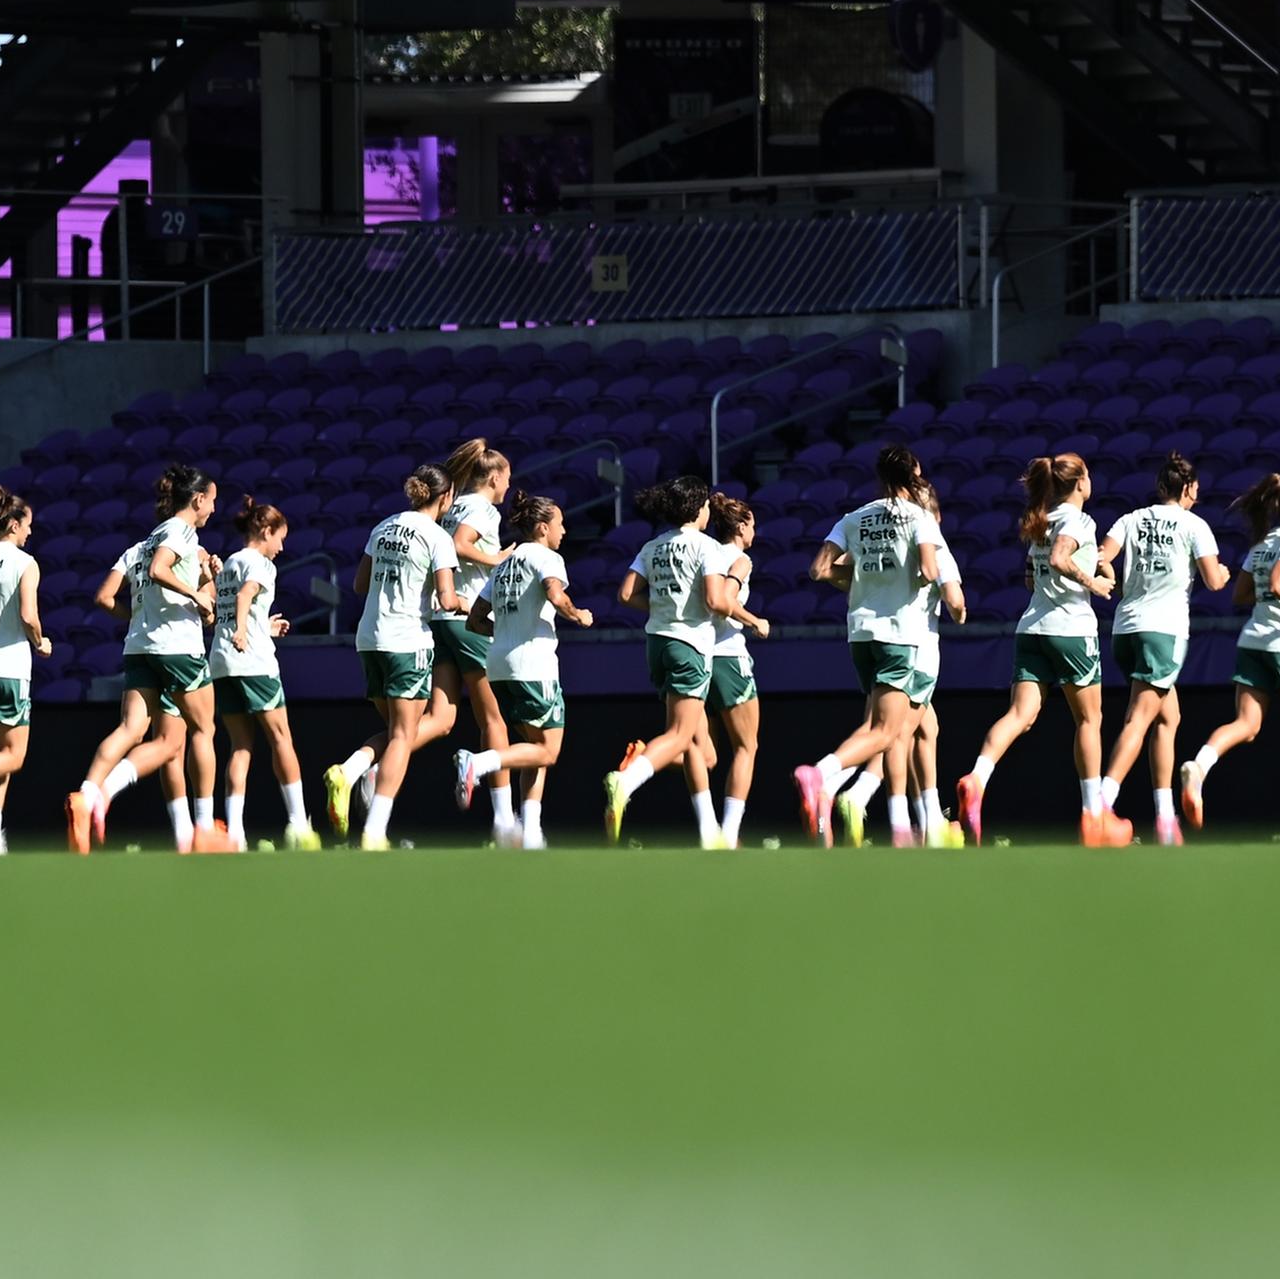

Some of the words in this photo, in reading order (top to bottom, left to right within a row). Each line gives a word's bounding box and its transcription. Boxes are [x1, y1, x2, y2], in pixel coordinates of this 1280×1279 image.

[161, 210, 186, 235] 29
[601, 262, 620, 283] 30
[875, 512, 897, 526] TIM
[1154, 519, 1177, 531] TIM
[393, 524, 416, 539] TIM
[860, 527, 897, 542] Poste
[1137, 530, 1174, 545] Poste
[377, 536, 410, 554] Poste
[666, 542, 686, 554] TIM
[652, 557, 683, 569] Poste
[1136, 561, 1151, 573] eni
